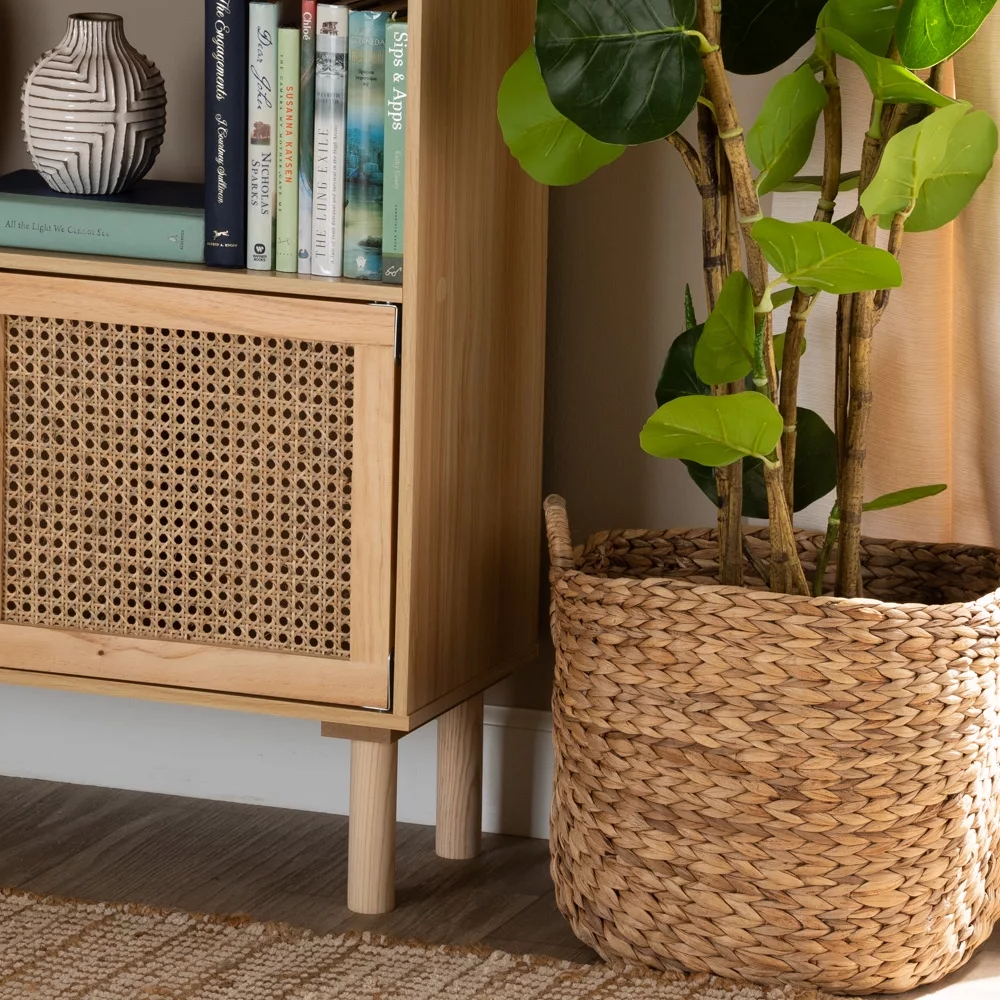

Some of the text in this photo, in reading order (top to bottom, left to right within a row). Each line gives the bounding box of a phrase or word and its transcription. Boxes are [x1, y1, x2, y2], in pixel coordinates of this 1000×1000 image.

[302, 11, 312, 40] Chloé
[212, 19, 231, 101] Engagements
[250, 25, 273, 110] Dear John
[388, 31, 408, 130] Sips & Apps
[215, 127, 228, 166] Courtney
[285, 86, 294, 183] SUSANNA KAYSEN
[216, 166, 228, 204] Sullivan
[251, 159, 261, 206] SPARKS
[260, 152, 272, 215] NICHOLAS
[316, 128, 329, 257] THE LONG EXILE
[4, 219, 17, 229] All
[18, 221, 30, 230] the
[32, 221, 52, 234] Light
[53, 223, 66, 233] We
